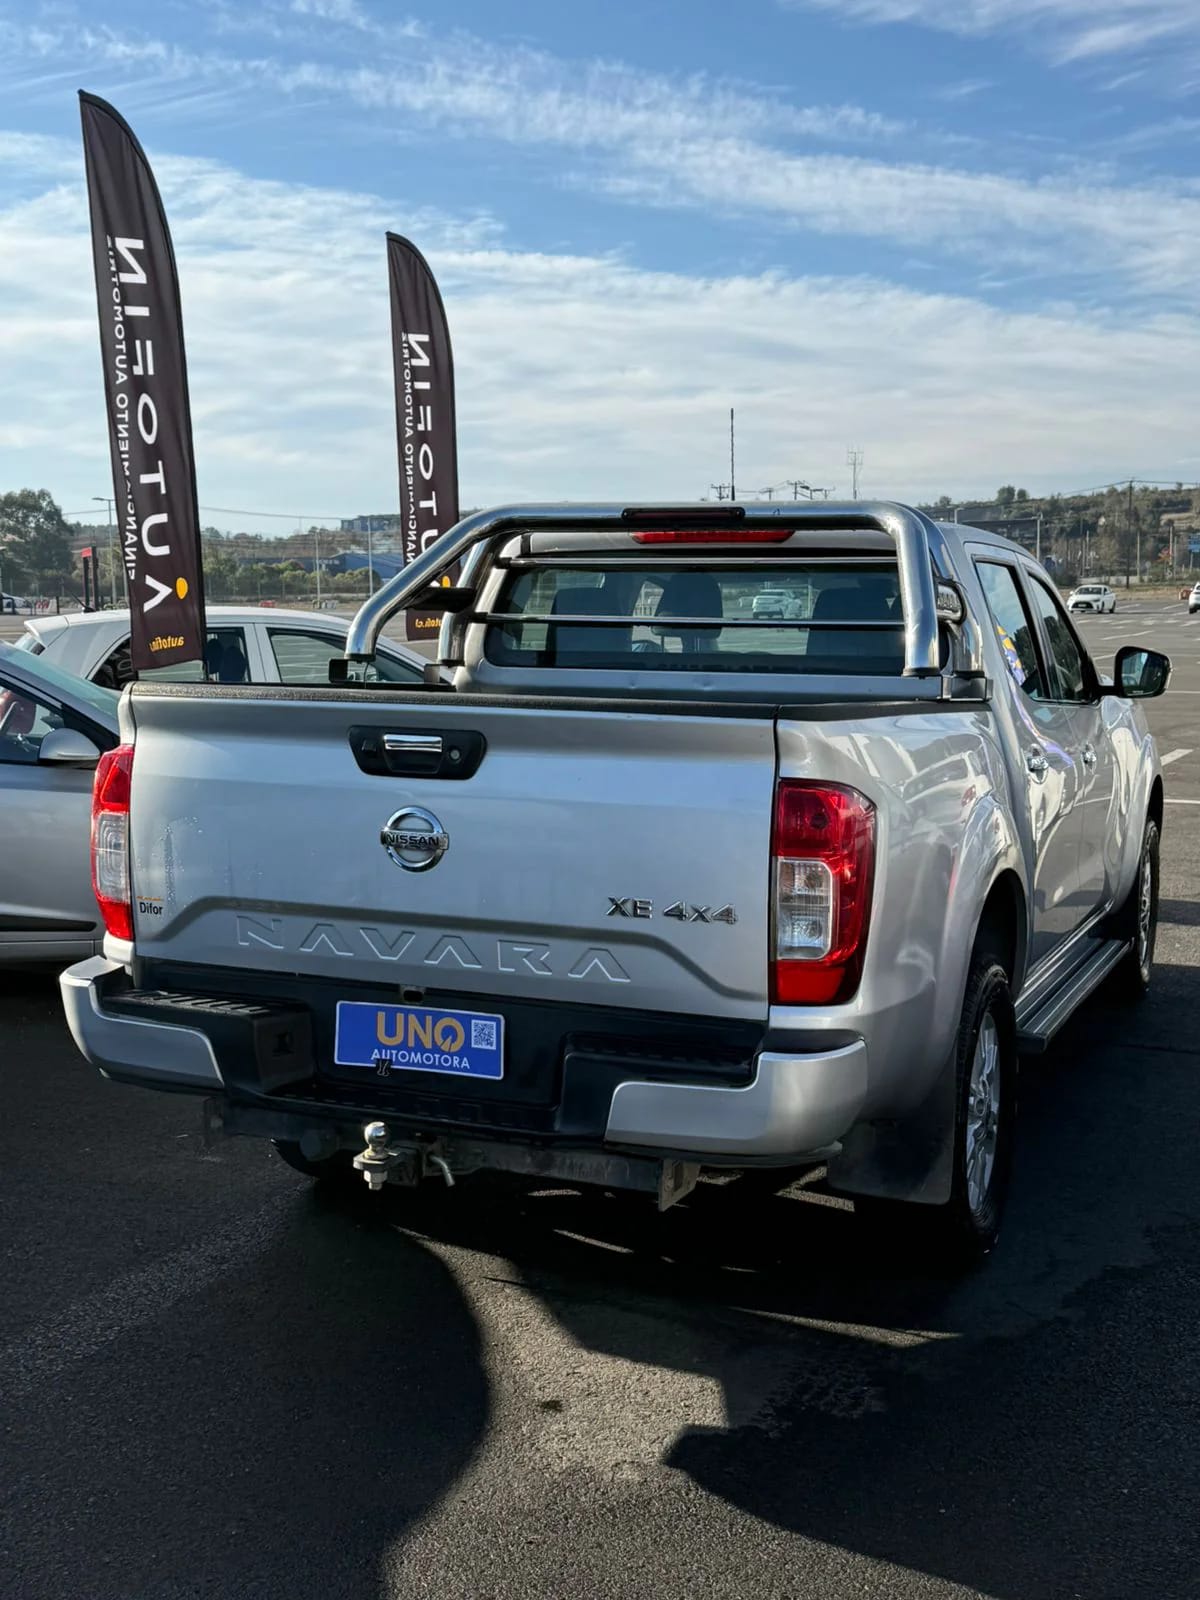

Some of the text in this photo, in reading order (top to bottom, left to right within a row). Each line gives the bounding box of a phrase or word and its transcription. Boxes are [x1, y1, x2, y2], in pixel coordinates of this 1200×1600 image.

[386, 834, 439, 847] NISSAN
[139, 902, 163, 915] Difor
[606, 896, 653, 919] XE
[236, 915, 632, 982] NAVARA
[376, 1011, 465, 1053] UNO
[370, 1049, 471, 1070] AUTOMOTORA
